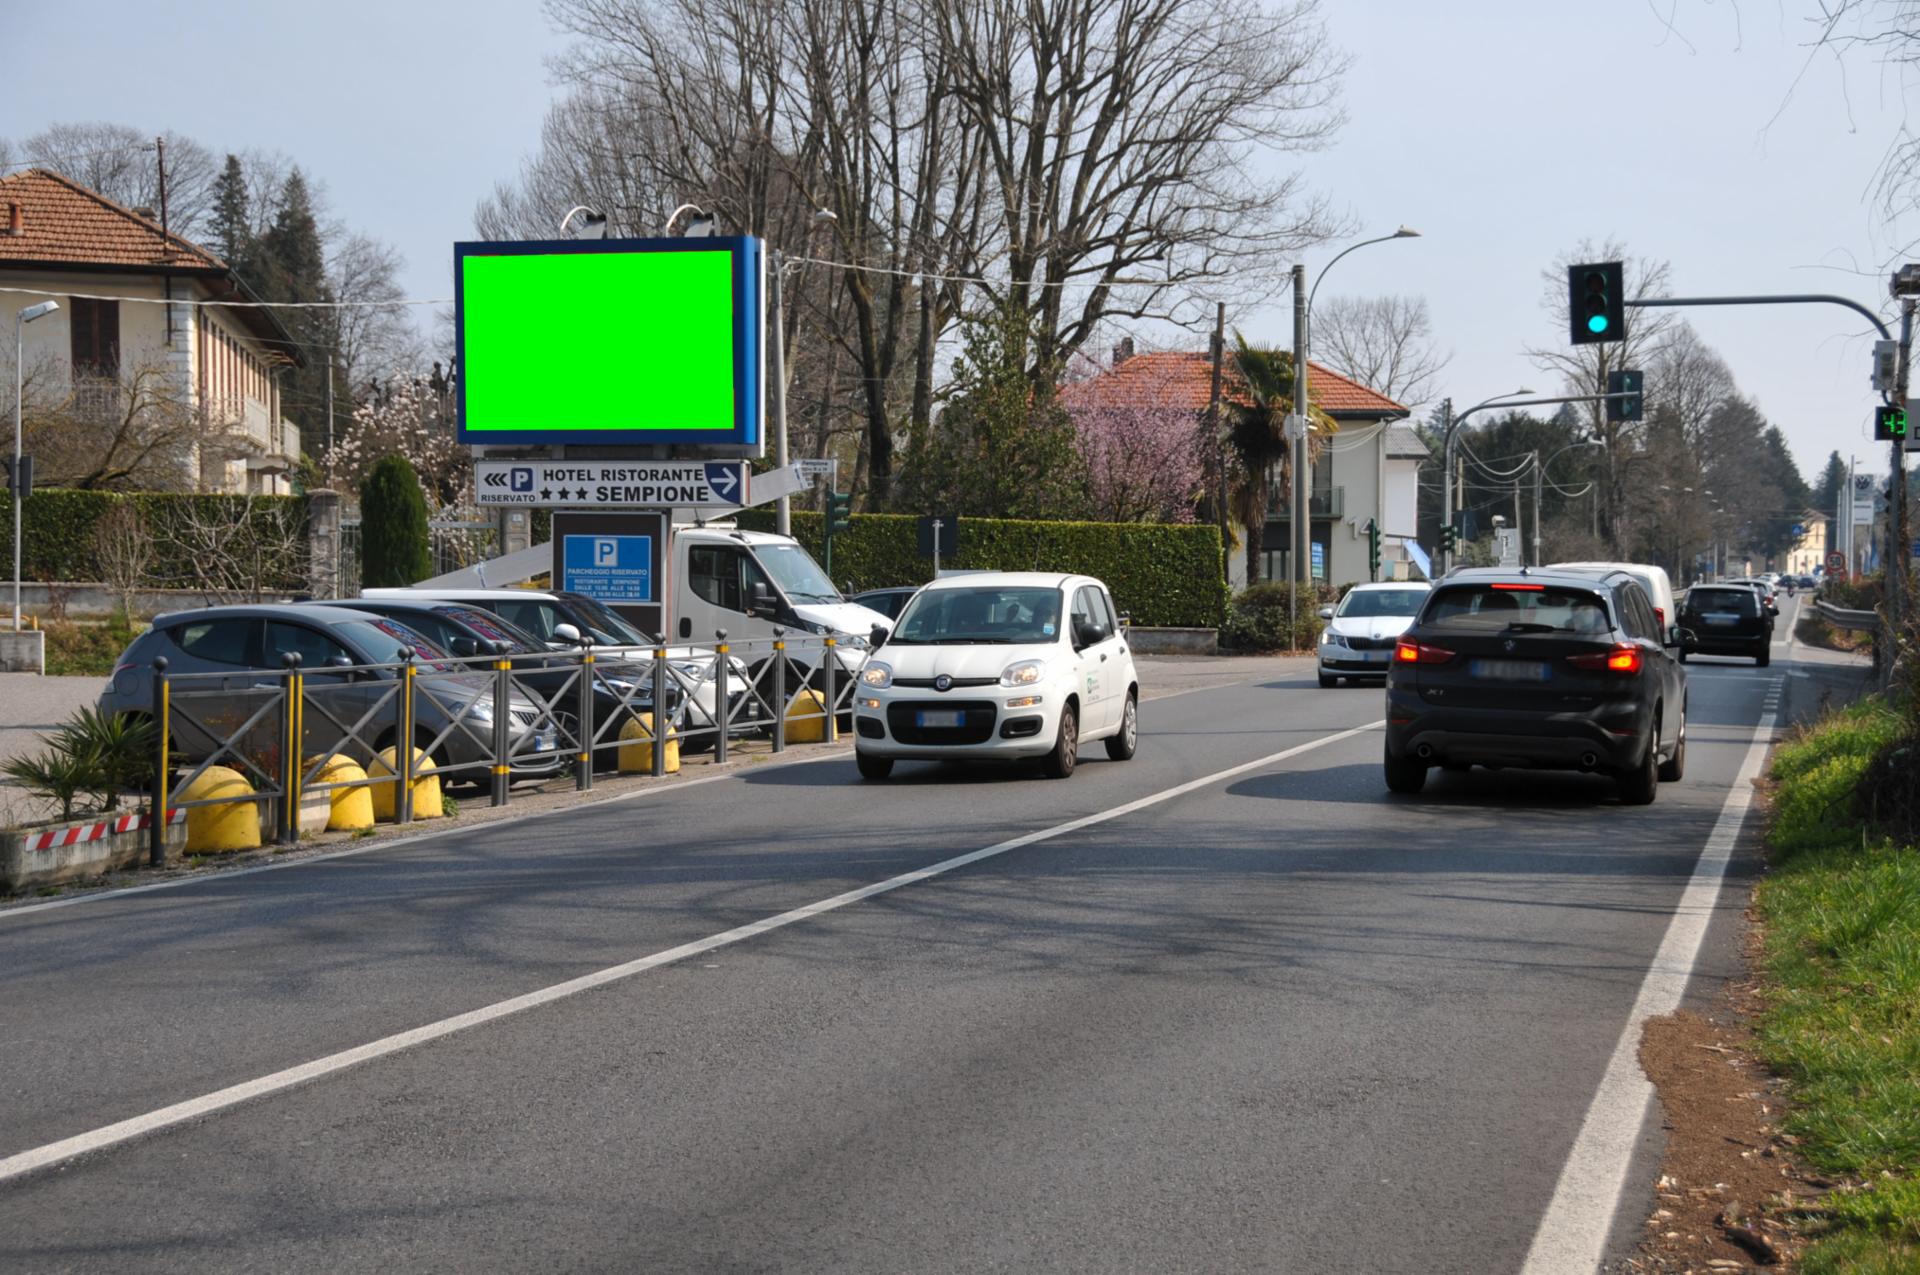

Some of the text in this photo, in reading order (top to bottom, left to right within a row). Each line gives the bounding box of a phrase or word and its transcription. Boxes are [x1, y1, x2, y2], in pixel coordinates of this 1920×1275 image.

[1882, 412, 1907, 434] 43
[515, 471, 529, 489] P
[543, 468, 704, 482] HOTEL RISTORANTE
[481, 494, 536, 503] RISERVATO
[596, 485, 709, 502] SEMPIONE
[599, 543, 614, 563] P
[1829, 556, 1841, 566] 50
[611, 568, 648, 576] RISERVATO
